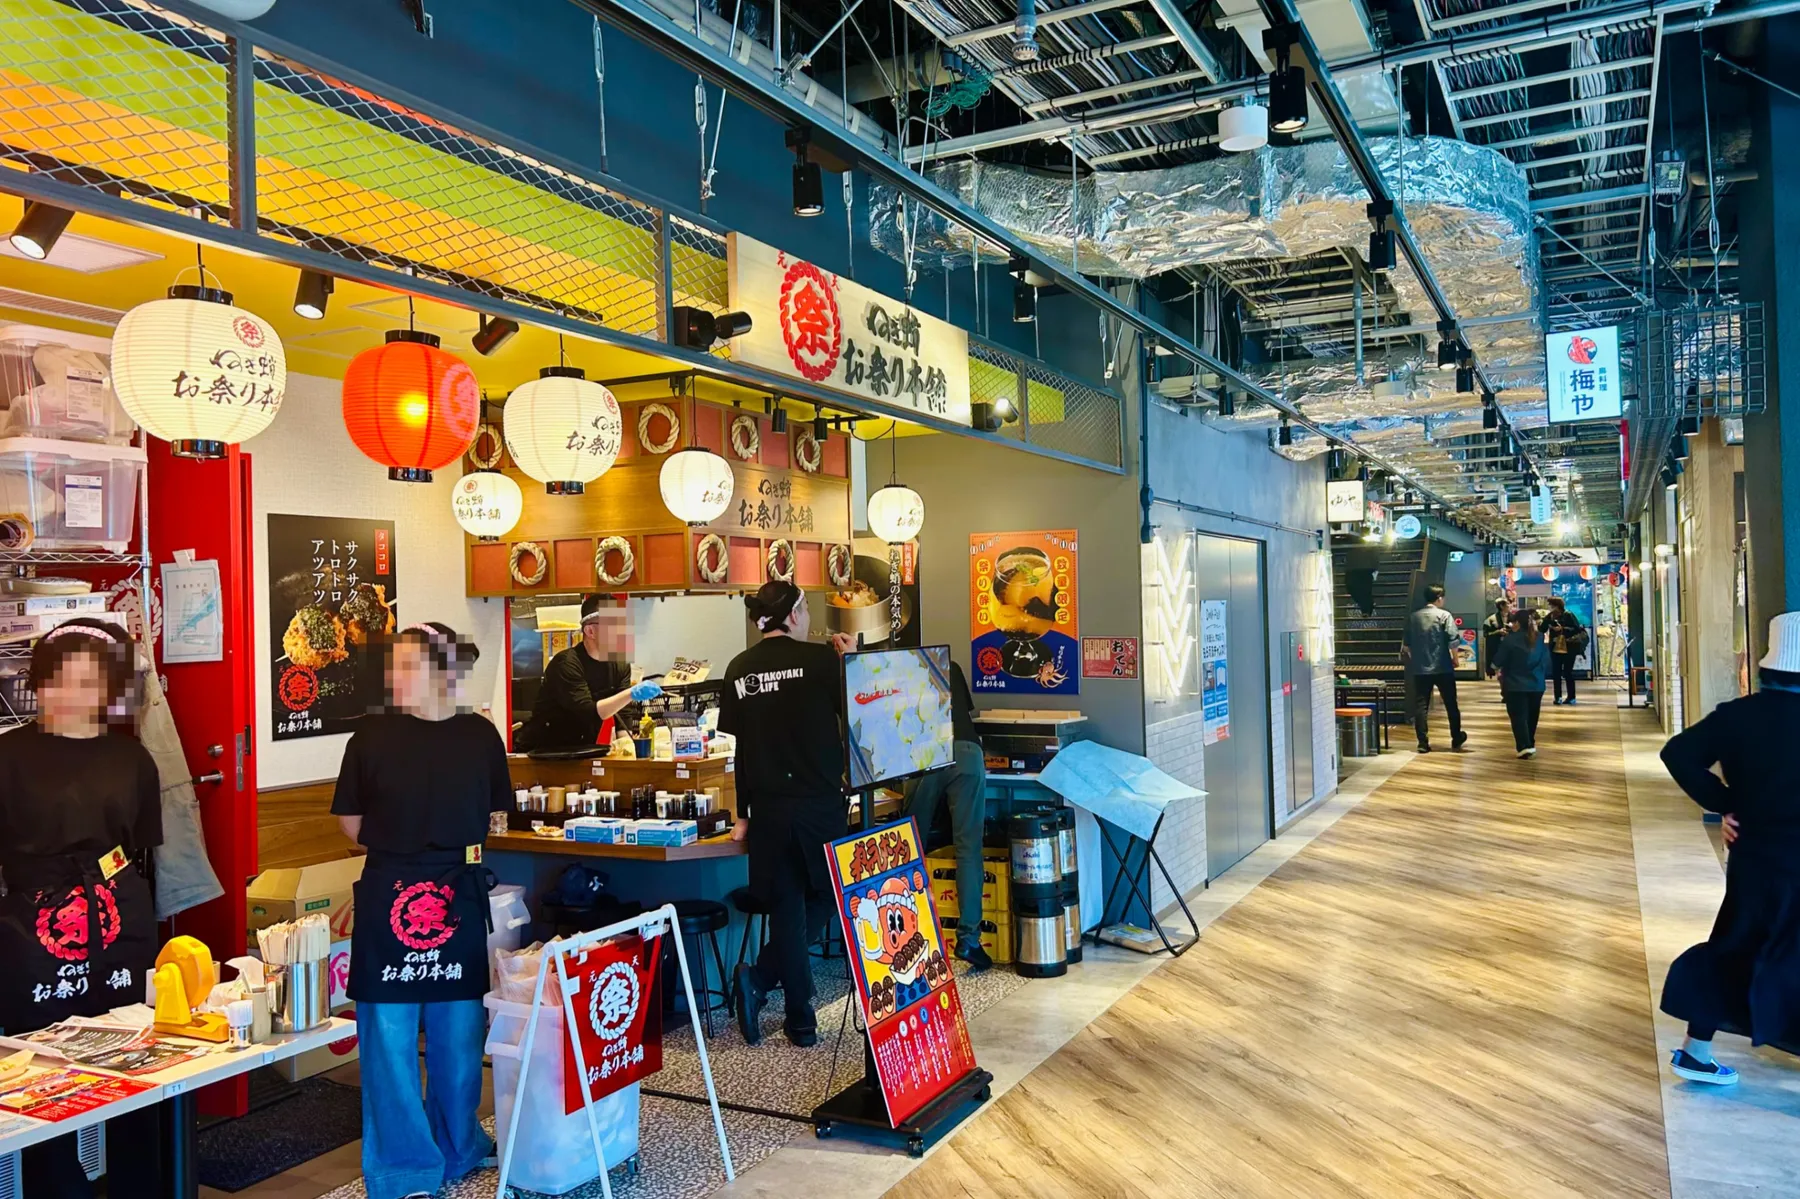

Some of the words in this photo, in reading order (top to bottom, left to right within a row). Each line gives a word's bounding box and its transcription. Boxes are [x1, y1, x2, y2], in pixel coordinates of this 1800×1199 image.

[776, 250, 788, 269] 元
[791, 281, 831, 357] 祭
[843, 339, 947, 415] お祭り本舗
[1570, 369, 1595, 415] 梅や
[739, 499, 814, 533] お祭り本舗
[378, 531, 387, 572] タココロ
[312, 539, 325, 604] アツアツ
[331, 539, 342, 603] トロトロ
[345, 540, 360, 604] サクサク
[1056, 557, 1068, 622] 数量限定
[288, 672, 310, 701] 祭
[758, 668, 804, 683] TAKOYAKI
[760, 681, 779, 693] LIFE
[392, 880, 404, 891] 元
[381, 962, 463, 982] お祭り本舗
[588, 970, 597, 983] 元
[631, 954, 640, 967] 天
[32, 967, 132, 1003] お祭り舗
[599, 975, 632, 1026] 祭
[588, 1043, 644, 1085] お祭り本舗
